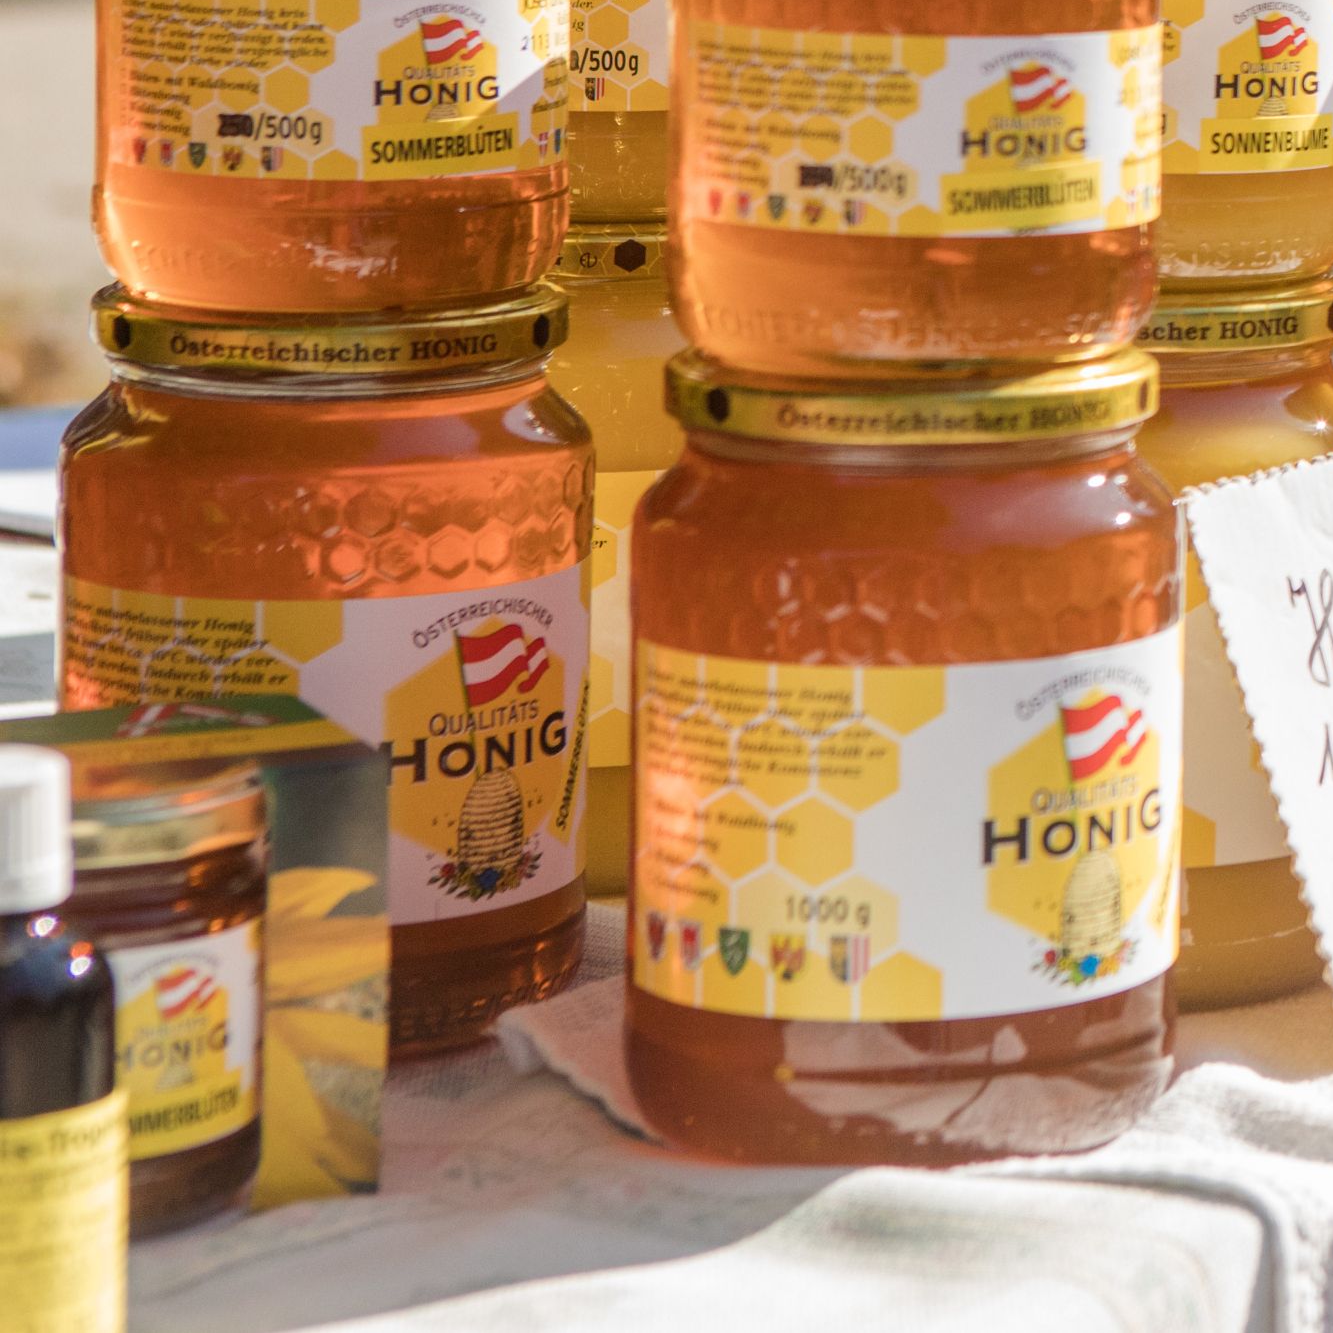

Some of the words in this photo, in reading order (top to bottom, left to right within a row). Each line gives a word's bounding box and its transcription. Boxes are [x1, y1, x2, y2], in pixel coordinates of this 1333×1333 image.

[374, 75, 500, 106] HONIG
[1214, 70, 1320, 99] HONIG
[371, 124, 514, 165] SOMMERBLÜTEN
[960, 125, 1089, 158] HONIG
[1210, 127, 1330, 155] SONNENBLUME
[1219, 316, 1299, 340] HONIG
[169, 332, 401, 363] Österreichischer
[409, 333, 499, 361] HONIG
[412, 597, 554, 650] ÖSTERREICHISCHER
[428, 698, 540, 738] QUALITÄTS
[380, 710, 568, 787] HONIG
[1030, 774, 1138, 817] QUALITÄTS
[980, 787, 1162, 866] HONIG
[784, 895, 849, 924] 1000
[854, 898, 870, 926] g
